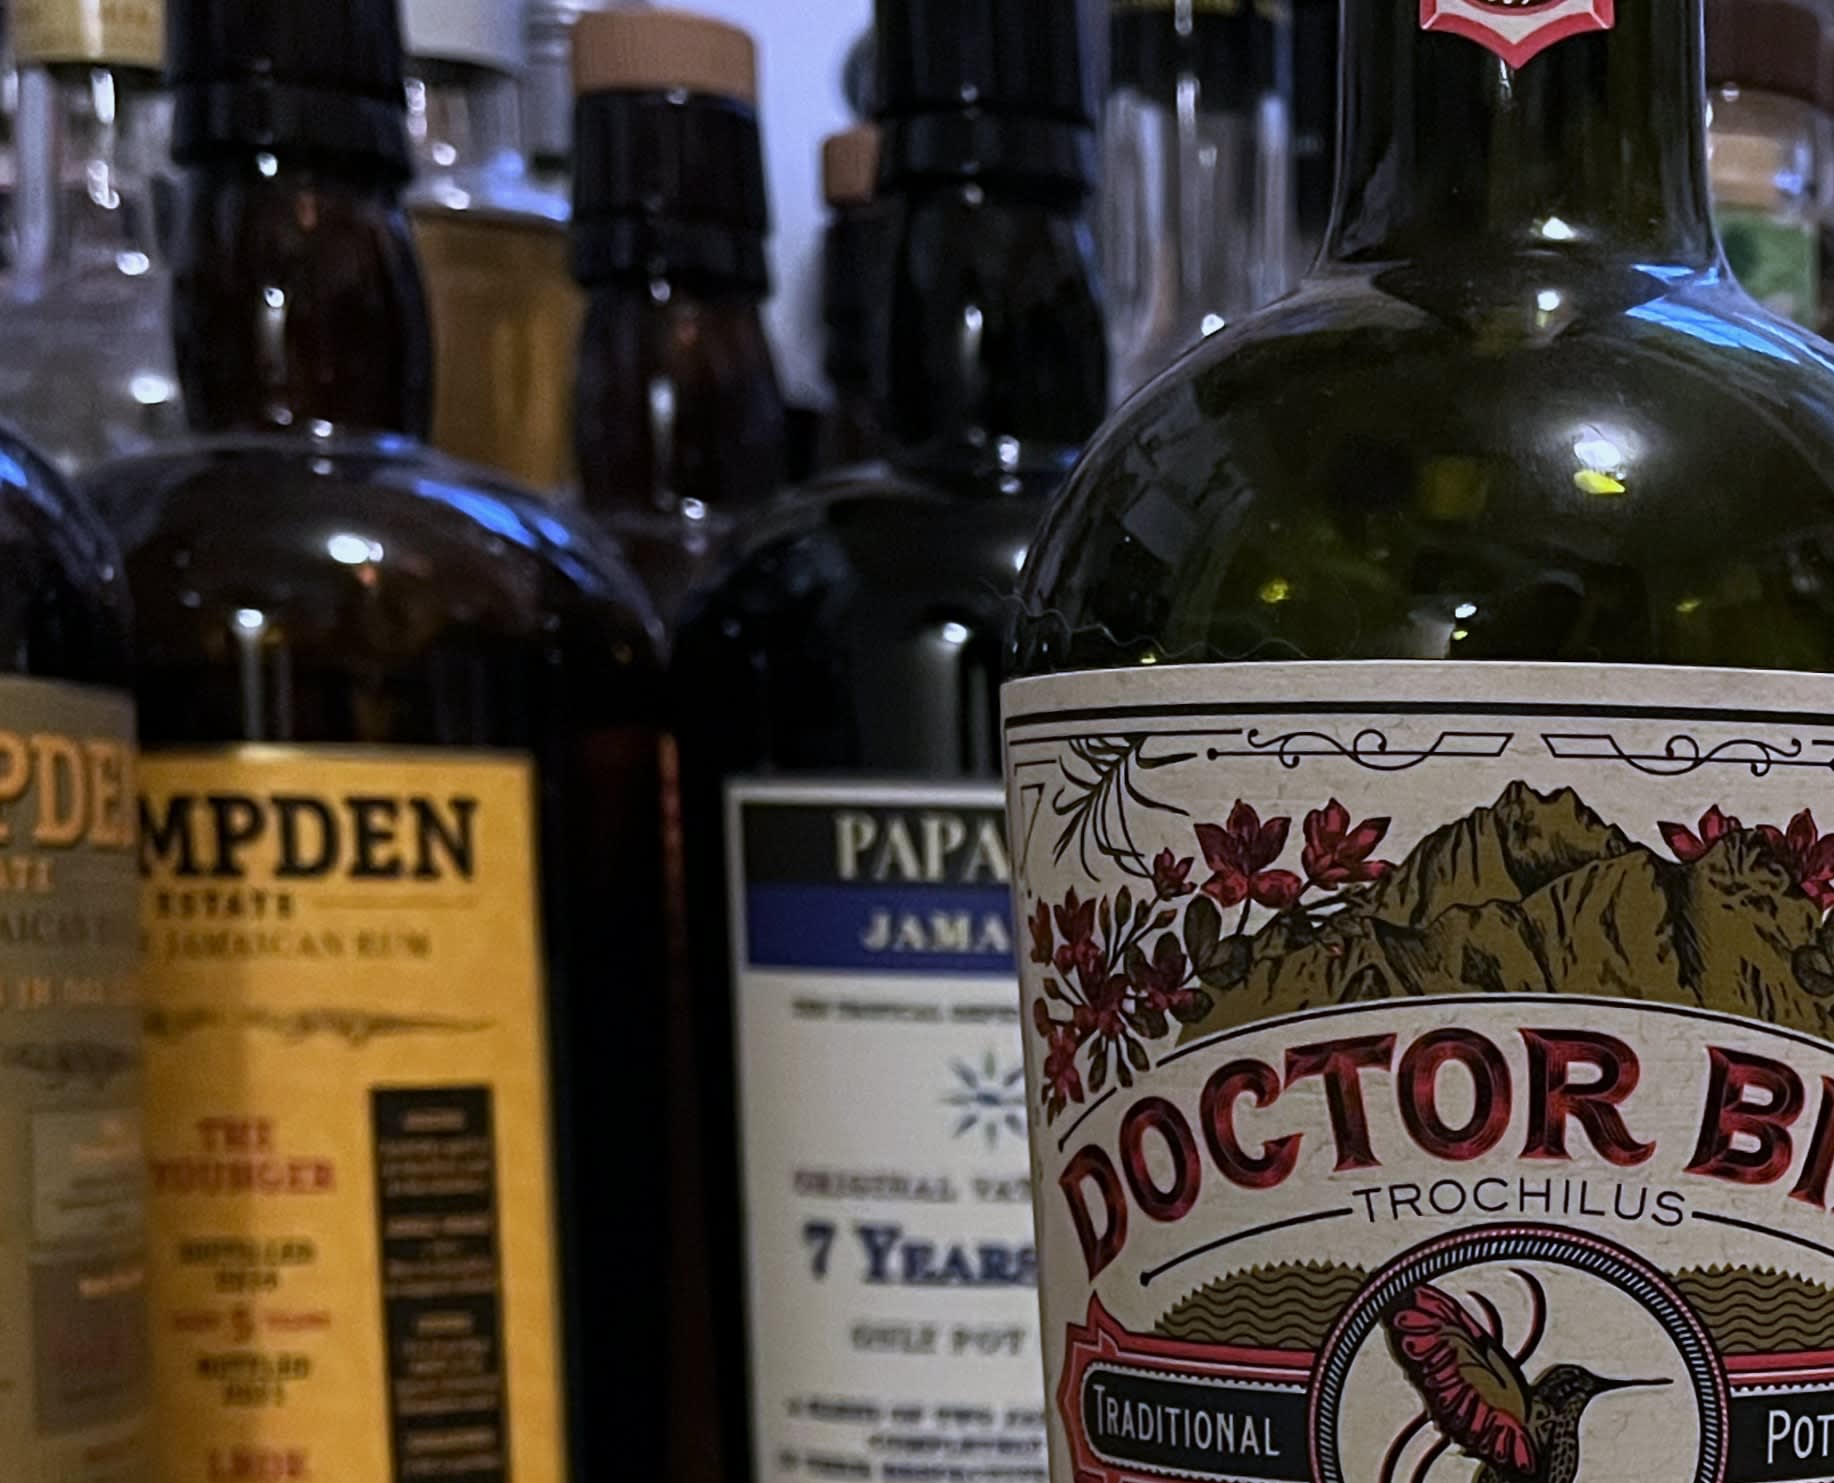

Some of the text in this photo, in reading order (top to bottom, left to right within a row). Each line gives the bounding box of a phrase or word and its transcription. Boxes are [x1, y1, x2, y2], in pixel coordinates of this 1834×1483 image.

[1056, 1025, 1657, 1283] DOCTOR
[1351, 1176, 1686, 1227] TROCHILUS
[803, 1219, 835, 1281] 7
[1092, 1382, 1281, 1459] TRADITIONAL
[1765, 1410, 1834, 1465] POT
